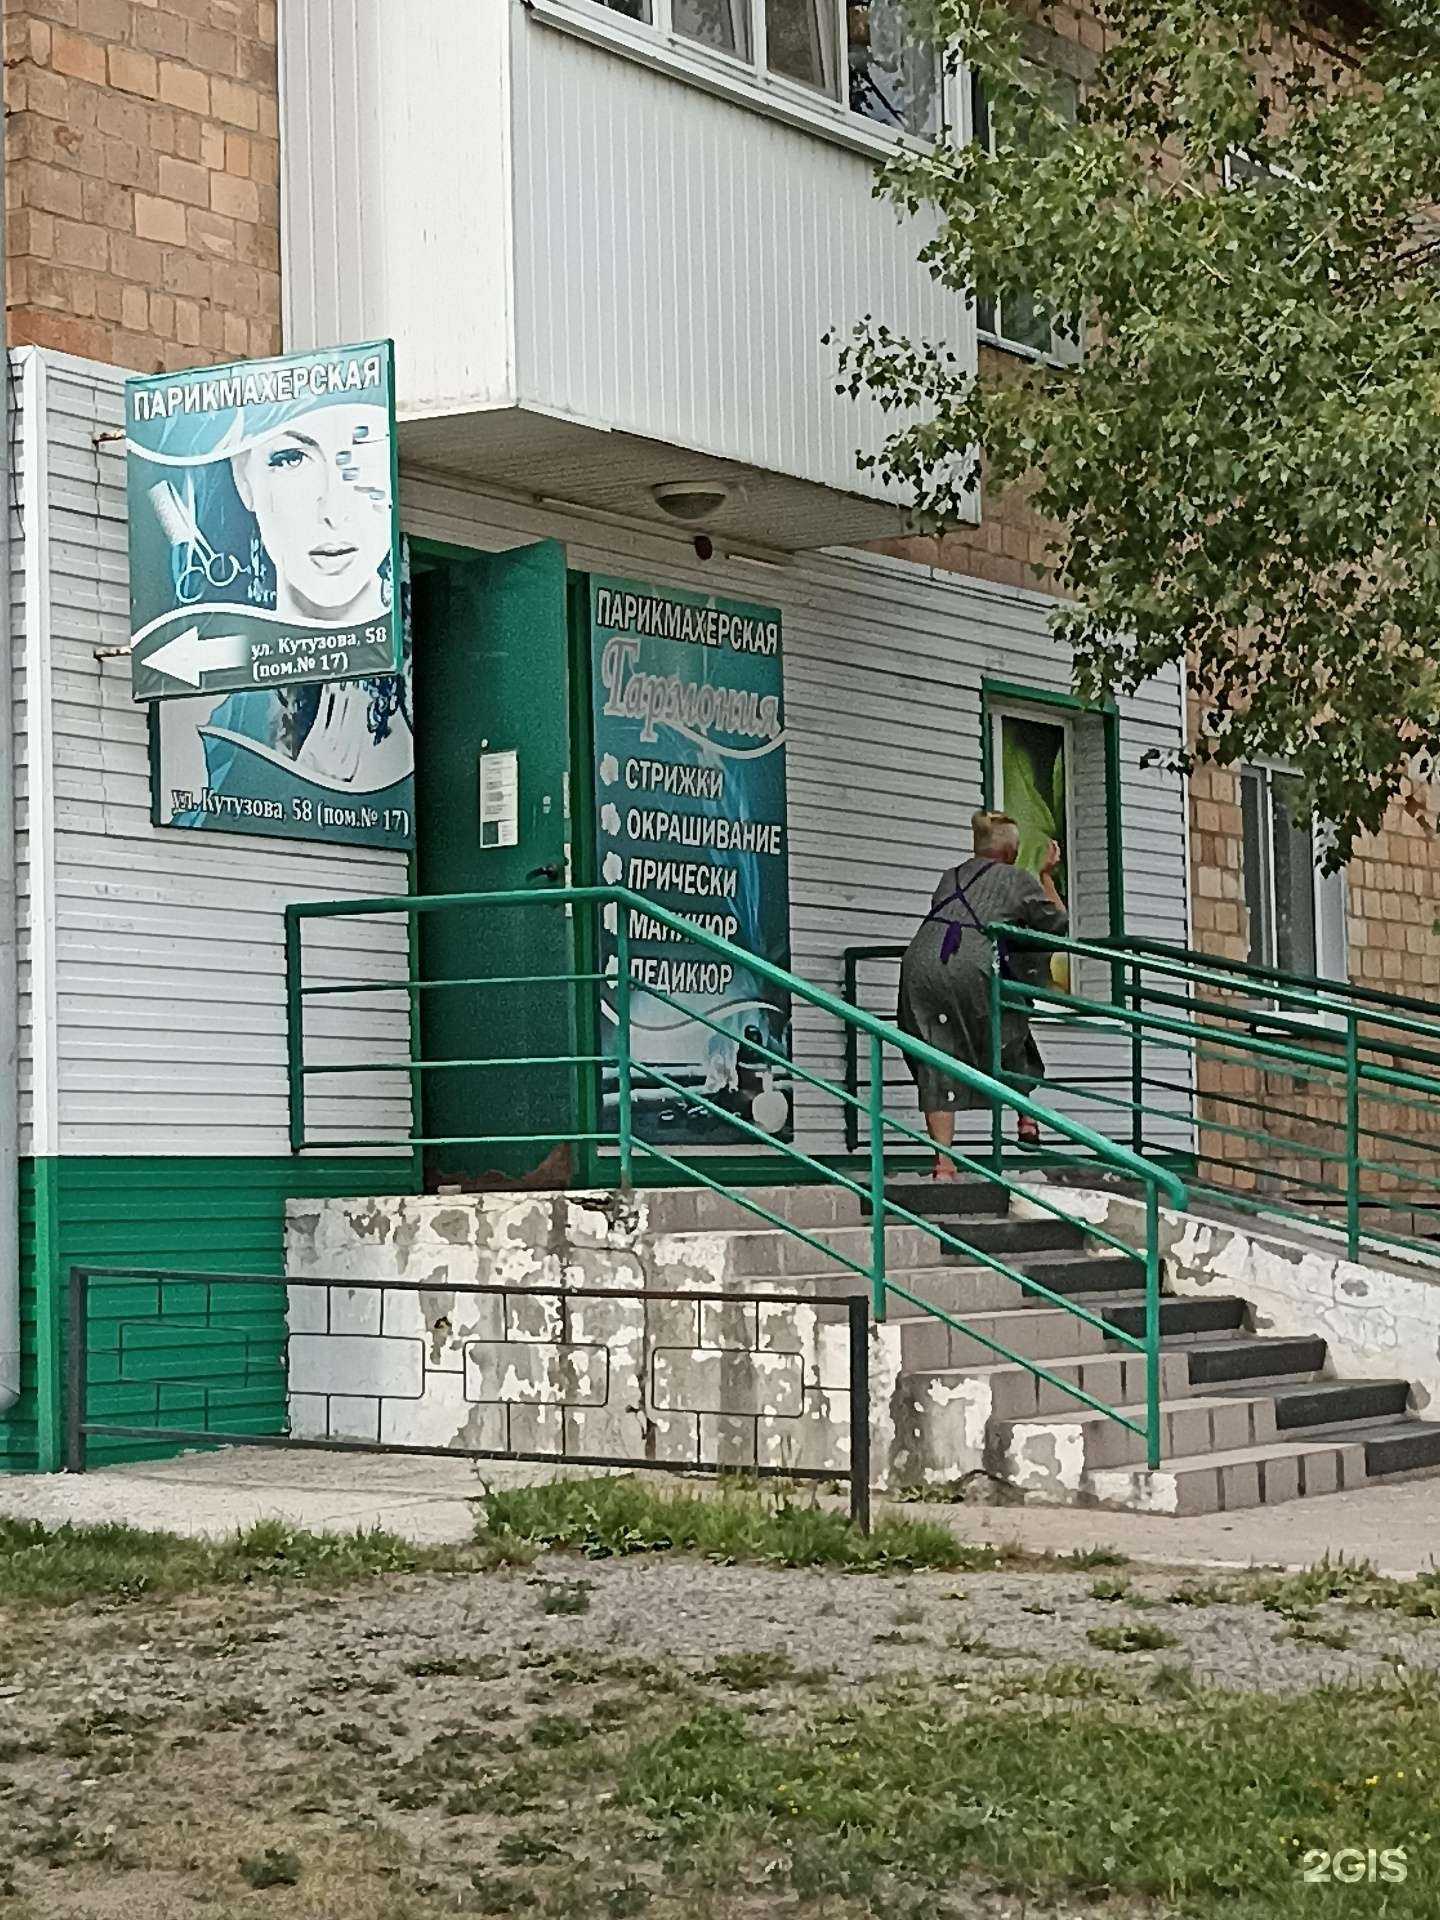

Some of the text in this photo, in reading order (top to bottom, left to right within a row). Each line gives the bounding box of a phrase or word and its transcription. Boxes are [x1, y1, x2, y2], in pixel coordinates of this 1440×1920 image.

[132, 356, 381, 421] ПАРИКМАХЕРСКАЯ
[597, 588, 778, 655] ПАРИКМАХЕРСКАЯ
[251, 627, 387, 660] ул. Кутузова, 58
[320, 652, 349, 672] 17)
[601, 636, 782, 743] Гармония
[625, 758, 724, 798] СТРИЖКИ
[202, 788, 287, 821] Кутузова,
[293, 798, 312, 821] 58
[384, 809, 409, 836] 17)
[626, 808, 782, 855] ОКРАШИВАНИЕ
[628, 858, 738, 898] ПРИЧЕСКИ
[629, 908, 738, 944] МАЮР
[630, 958, 733, 996] ПЕДИКЮР
